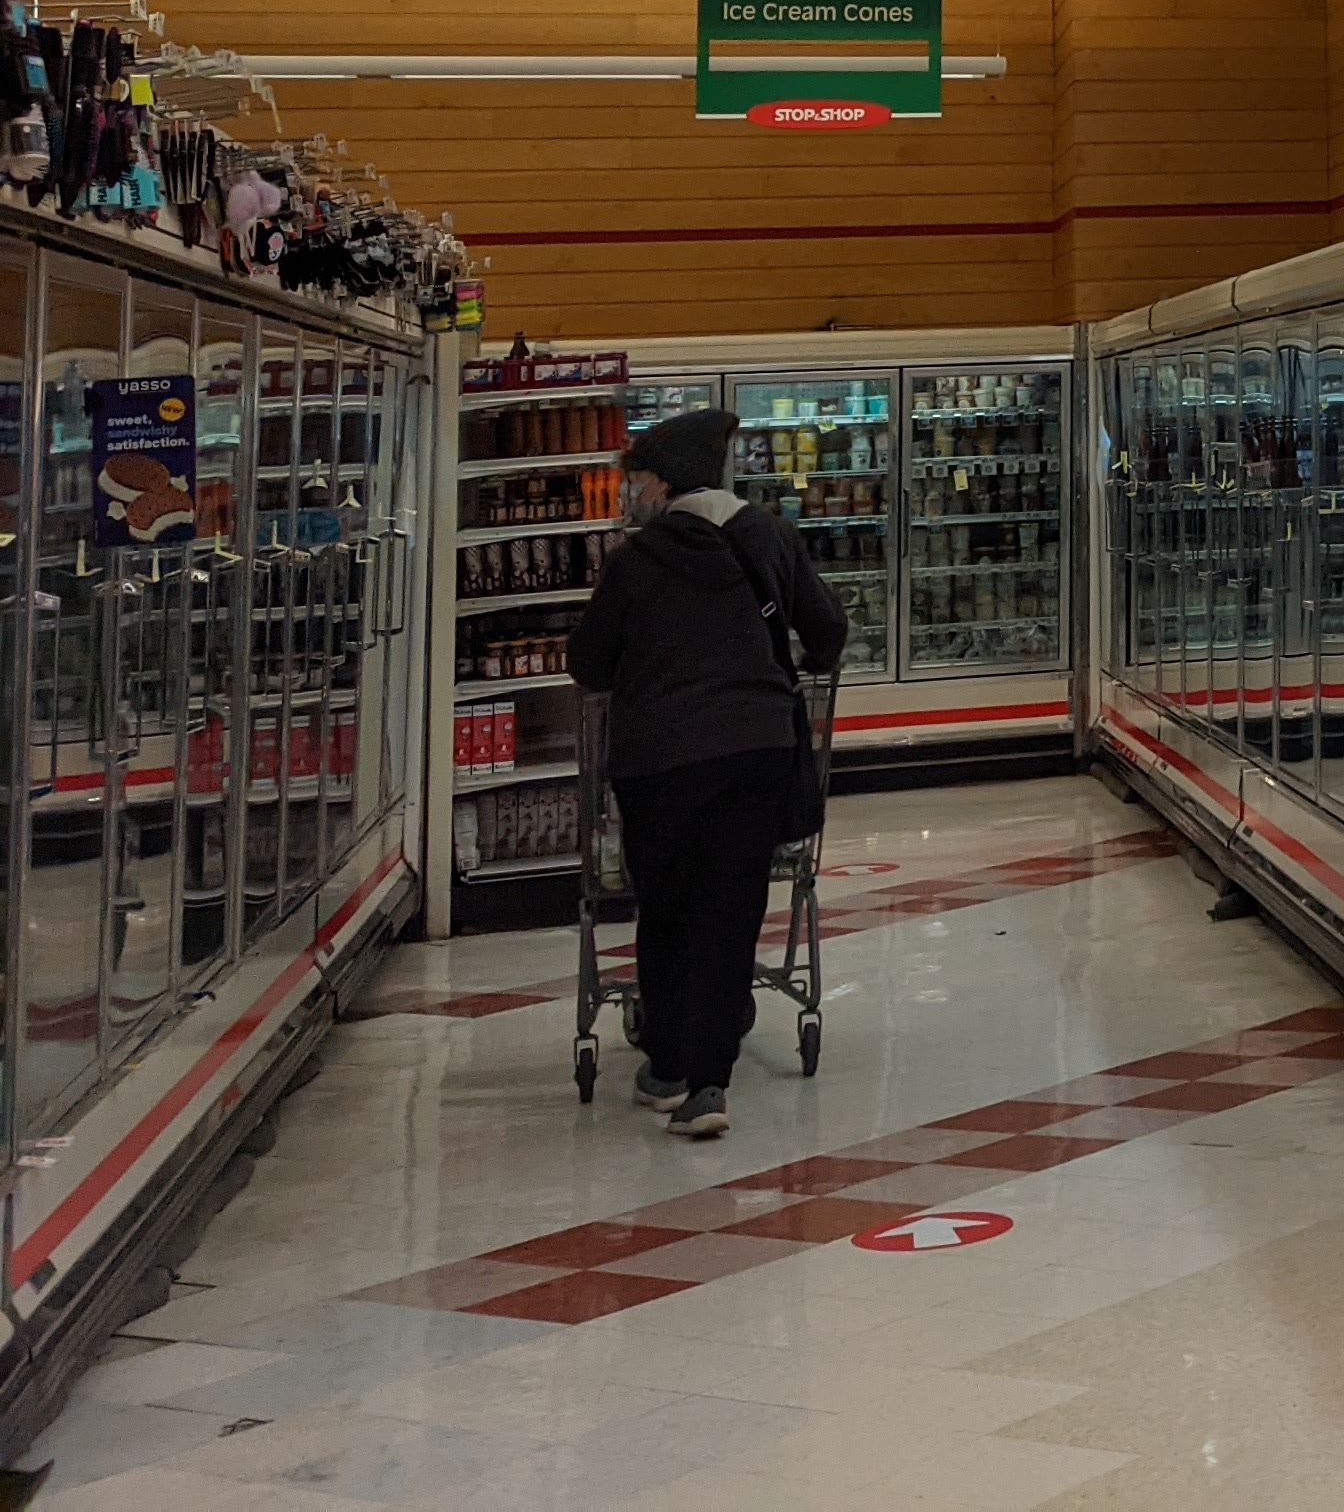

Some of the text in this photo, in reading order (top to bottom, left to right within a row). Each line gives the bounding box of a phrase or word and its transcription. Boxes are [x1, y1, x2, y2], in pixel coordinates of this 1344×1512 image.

[723, 2, 913, 22] Ice Cream Cones
[119, 380, 170, 395] yasso
[107, 414, 152, 426] sweet.
[107, 437, 190, 451] satisfaction.
